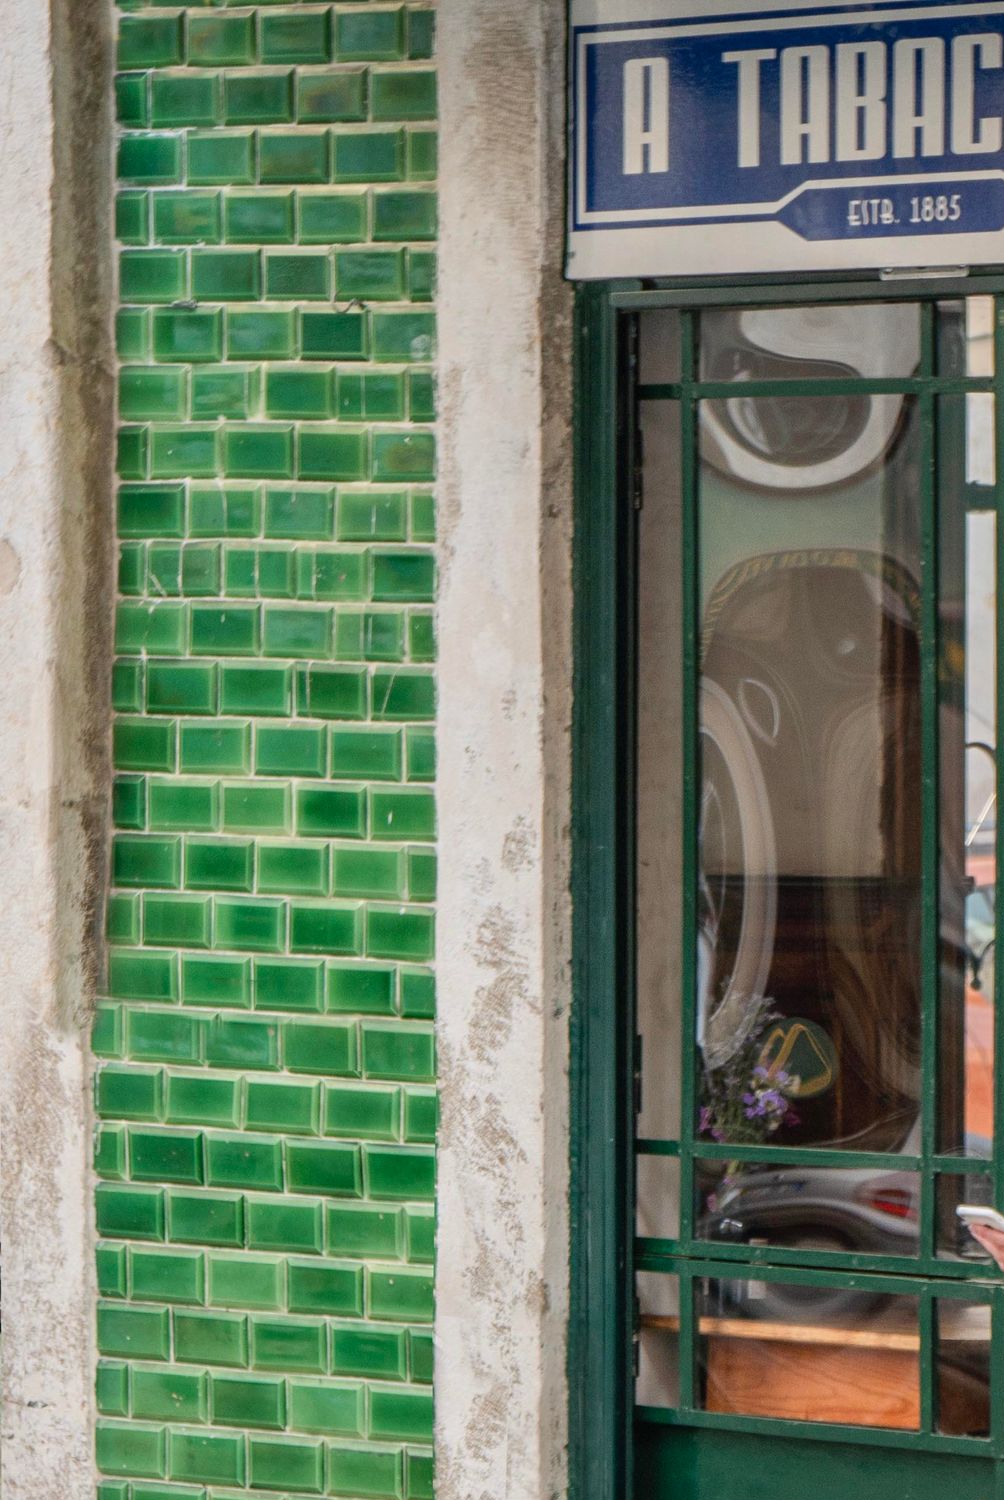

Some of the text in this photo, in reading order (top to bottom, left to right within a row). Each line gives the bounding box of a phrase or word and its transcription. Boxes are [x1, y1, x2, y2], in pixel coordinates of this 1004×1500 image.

[622, 56, 669, 175] A
[847, 195, 961, 226] ESTB. 1885
